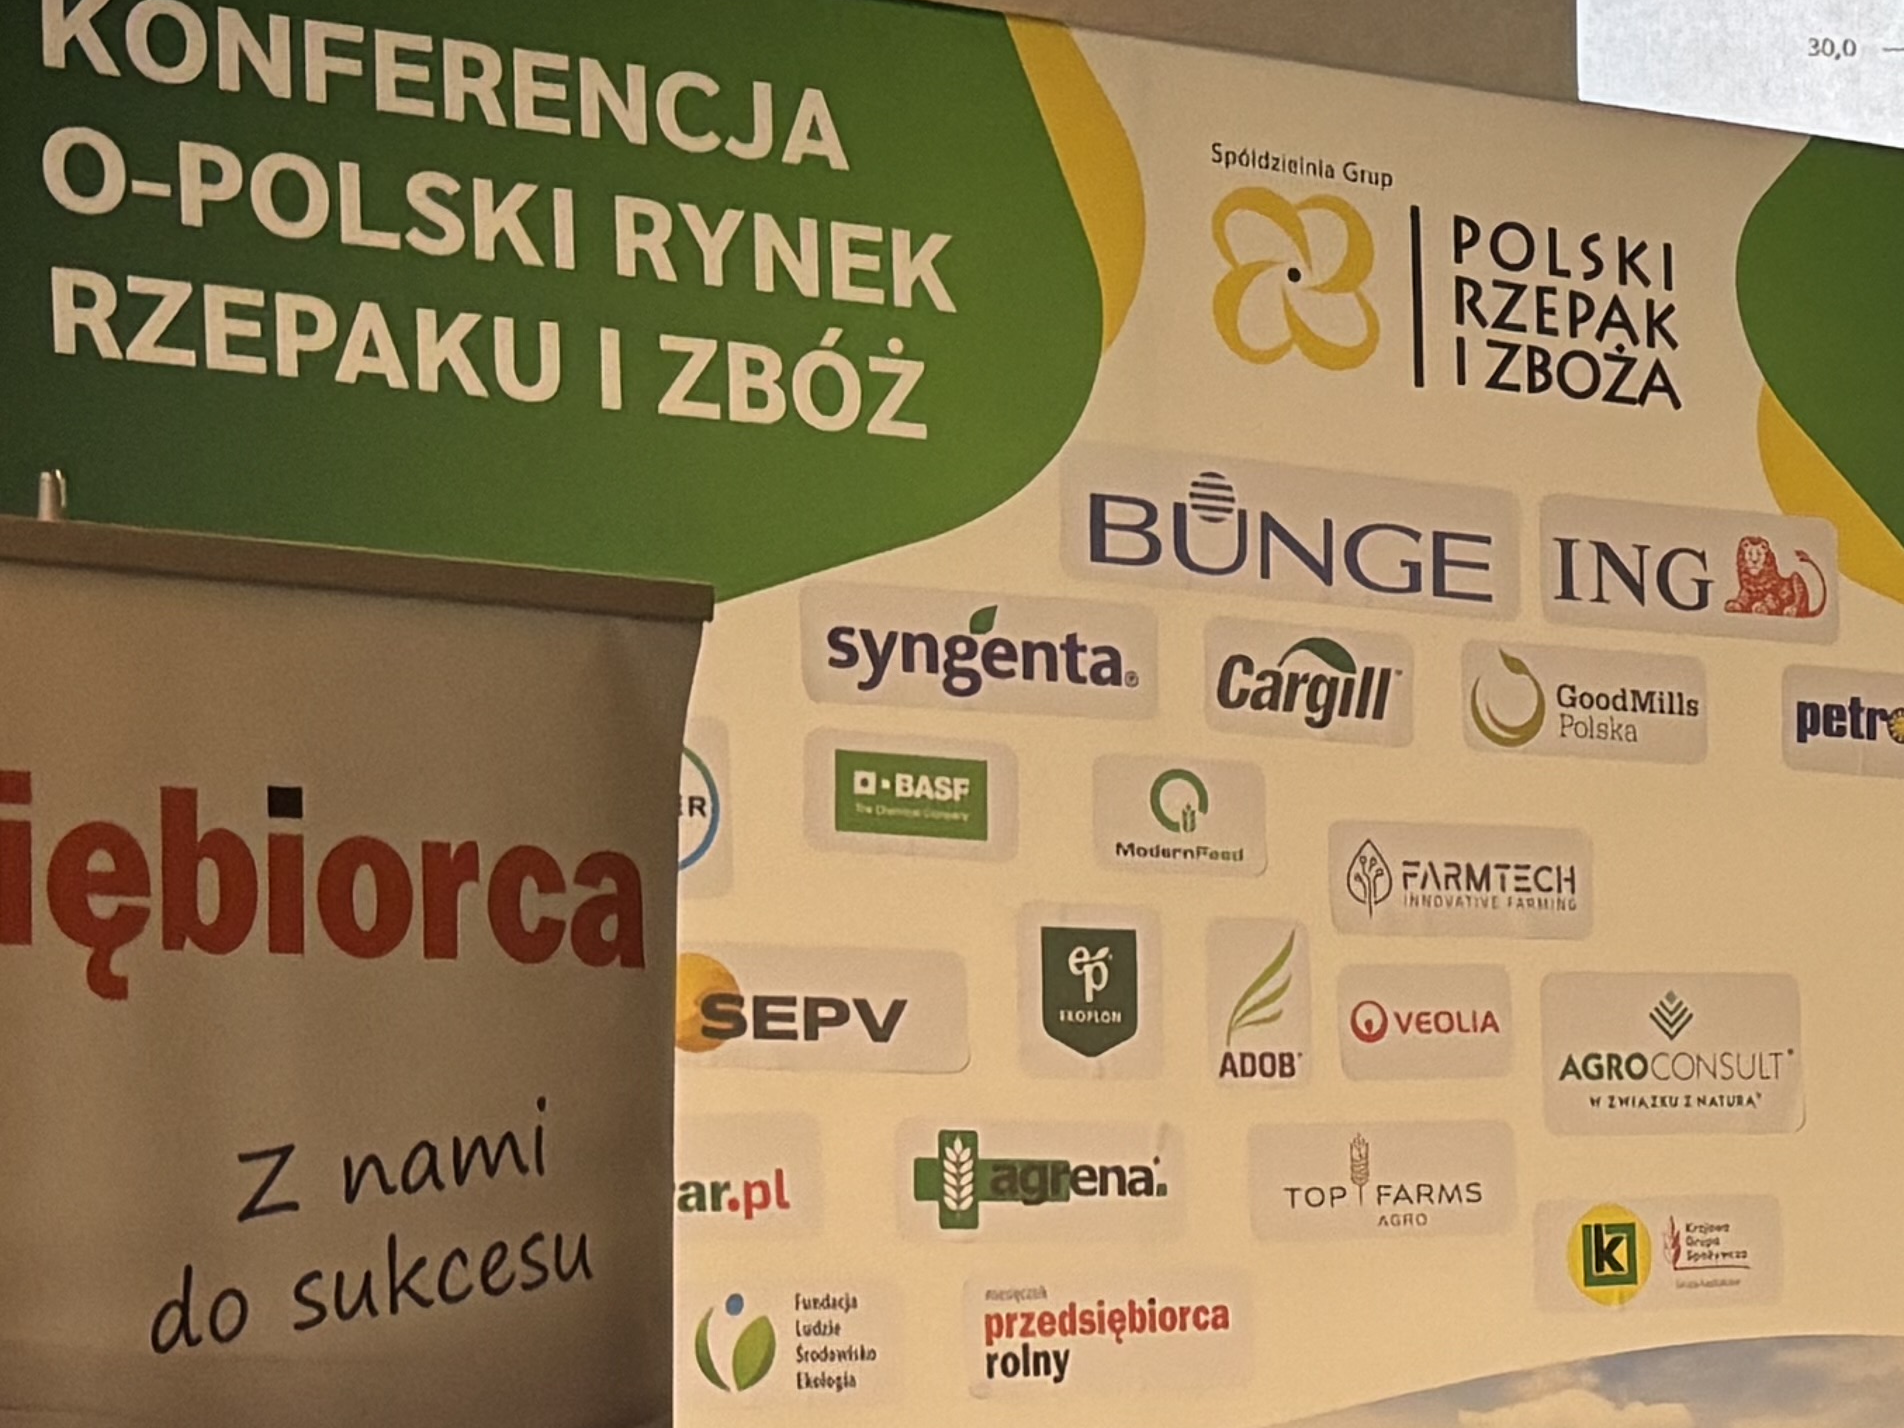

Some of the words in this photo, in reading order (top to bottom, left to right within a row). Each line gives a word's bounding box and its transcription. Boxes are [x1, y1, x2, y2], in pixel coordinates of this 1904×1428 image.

[1807, 37, 1858, 60] 30,0
[1343, 162, 1393, 190] Grup
[41, 127, 574, 271] O-POLSKI
[615, 195, 956, 313] RYNEK
[1454, 214, 1674, 289] POLSKI
[1454, 277, 1679, 353] RZEPAK
[50, 267, 560, 402] RZEPAKU
[600, 327, 621, 410] I
[658, 327, 928, 440] ZBÓŻ
[1455, 336, 1466, 385] I
[1486, 339, 1683, 410] ZBOŻA
[1089, 488, 1493, 601] BUNGE
[1554, 536, 1712, 612] ING
[826, 622, 1122, 697] syngenta
[1217, 653, 1392, 728] Cargill
[1556, 684, 1699, 717] GoodMills
[1559, 714, 1638, 743] Polska
[896, 773, 970, 801] BASF
[1402, 860, 1575, 894] FARMTECH
[700, 992, 907, 1042] SEPV
[1394, 1009, 1500, 1035] VEOLIA
[1219, 1051, 1296, 1079] ADOB
[1559, 1052, 1783, 1081] AGROCONSULT
[343, 1097, 547, 1204] nami
[676, 1168, 790, 1220] ar.pl
[1284, 1186, 1347, 1208] TOP
[1377, 1182, 1482, 1205] FARMS
[1378, 1213, 1427, 1226] AGRO
[151, 1266, 247, 1354] do
[293, 1232, 592, 1331] sukcesu
[985, 1298, 1229, 1346] przedsiębiorca
[986, 1343, 1069, 1383] rolny
